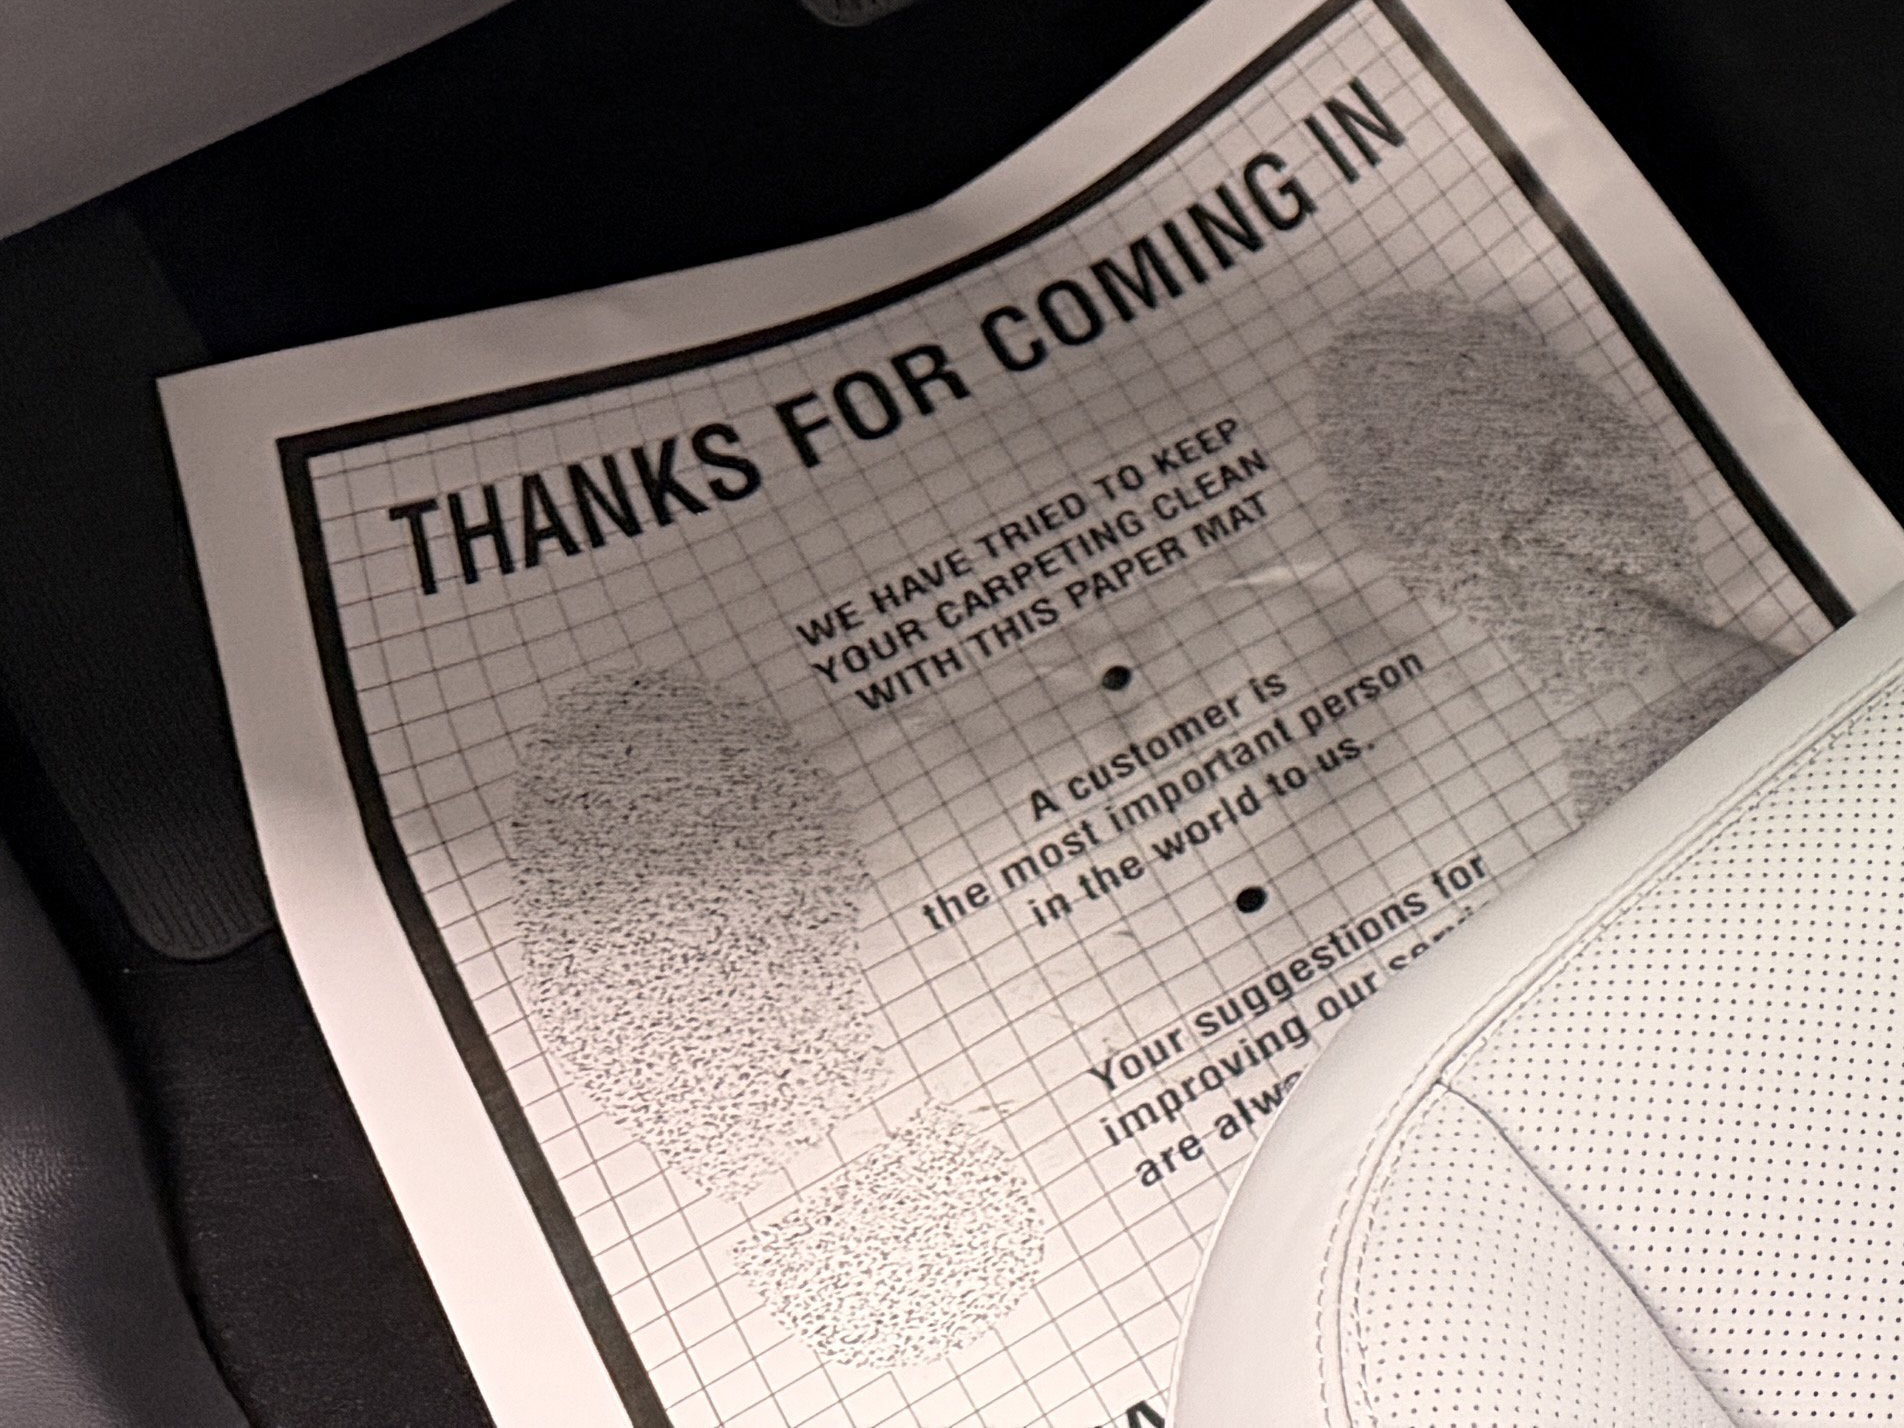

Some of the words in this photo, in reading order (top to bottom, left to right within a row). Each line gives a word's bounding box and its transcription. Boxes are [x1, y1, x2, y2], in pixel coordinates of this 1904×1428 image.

[389, 423, 761, 597] THANKS
[776, 342, 970, 470] FOR
[977, 150, 1317, 373] COMING
[1302, 76, 1408, 185] IN
[796, 600, 864, 646] WE
[869, 549, 972, 614] HAVE
[975, 492, 1086, 560] TRIED
[1093, 464, 1145, 502] TO
[1150, 417, 1239, 475] KEEP
[812, 618, 928, 685] YOUR
[935, 509, 1144, 630] CARPETING
[1150, 449, 1269, 521] CLEAN
[855, 648, 964, 712] WITH
[967, 597, 1060, 658] THIS
[1064, 537, 1187, 610] PAPER
[1193, 490, 1268, 549] MAT
[923, 880, 991, 932] the
[1001, 821, 1103, 890] most
[1108, 716, 1296, 833] important
[1300, 650, 1425, 736] person
[1028, 894, 1073, 927] in
[1079, 853, 1146, 902] the
[1152, 784, 1263, 863] world
[1266, 763, 1309, 798] to
[1316, 735, 1376, 772] us.
[1030, 789, 1061, 822] A
[1068, 698, 1242, 803] customer
[1250, 671, 1288, 705] is
[1088, 1026, 1184, 1092] Your
[1194, 891, 1429, 1039] suggestions
[1431, 854, 1488, 900] for
[1100, 1014, 1311, 1146] improving
[1316, 970, 1380, 1023] our
[1135, 1133, 1203, 1187] are
